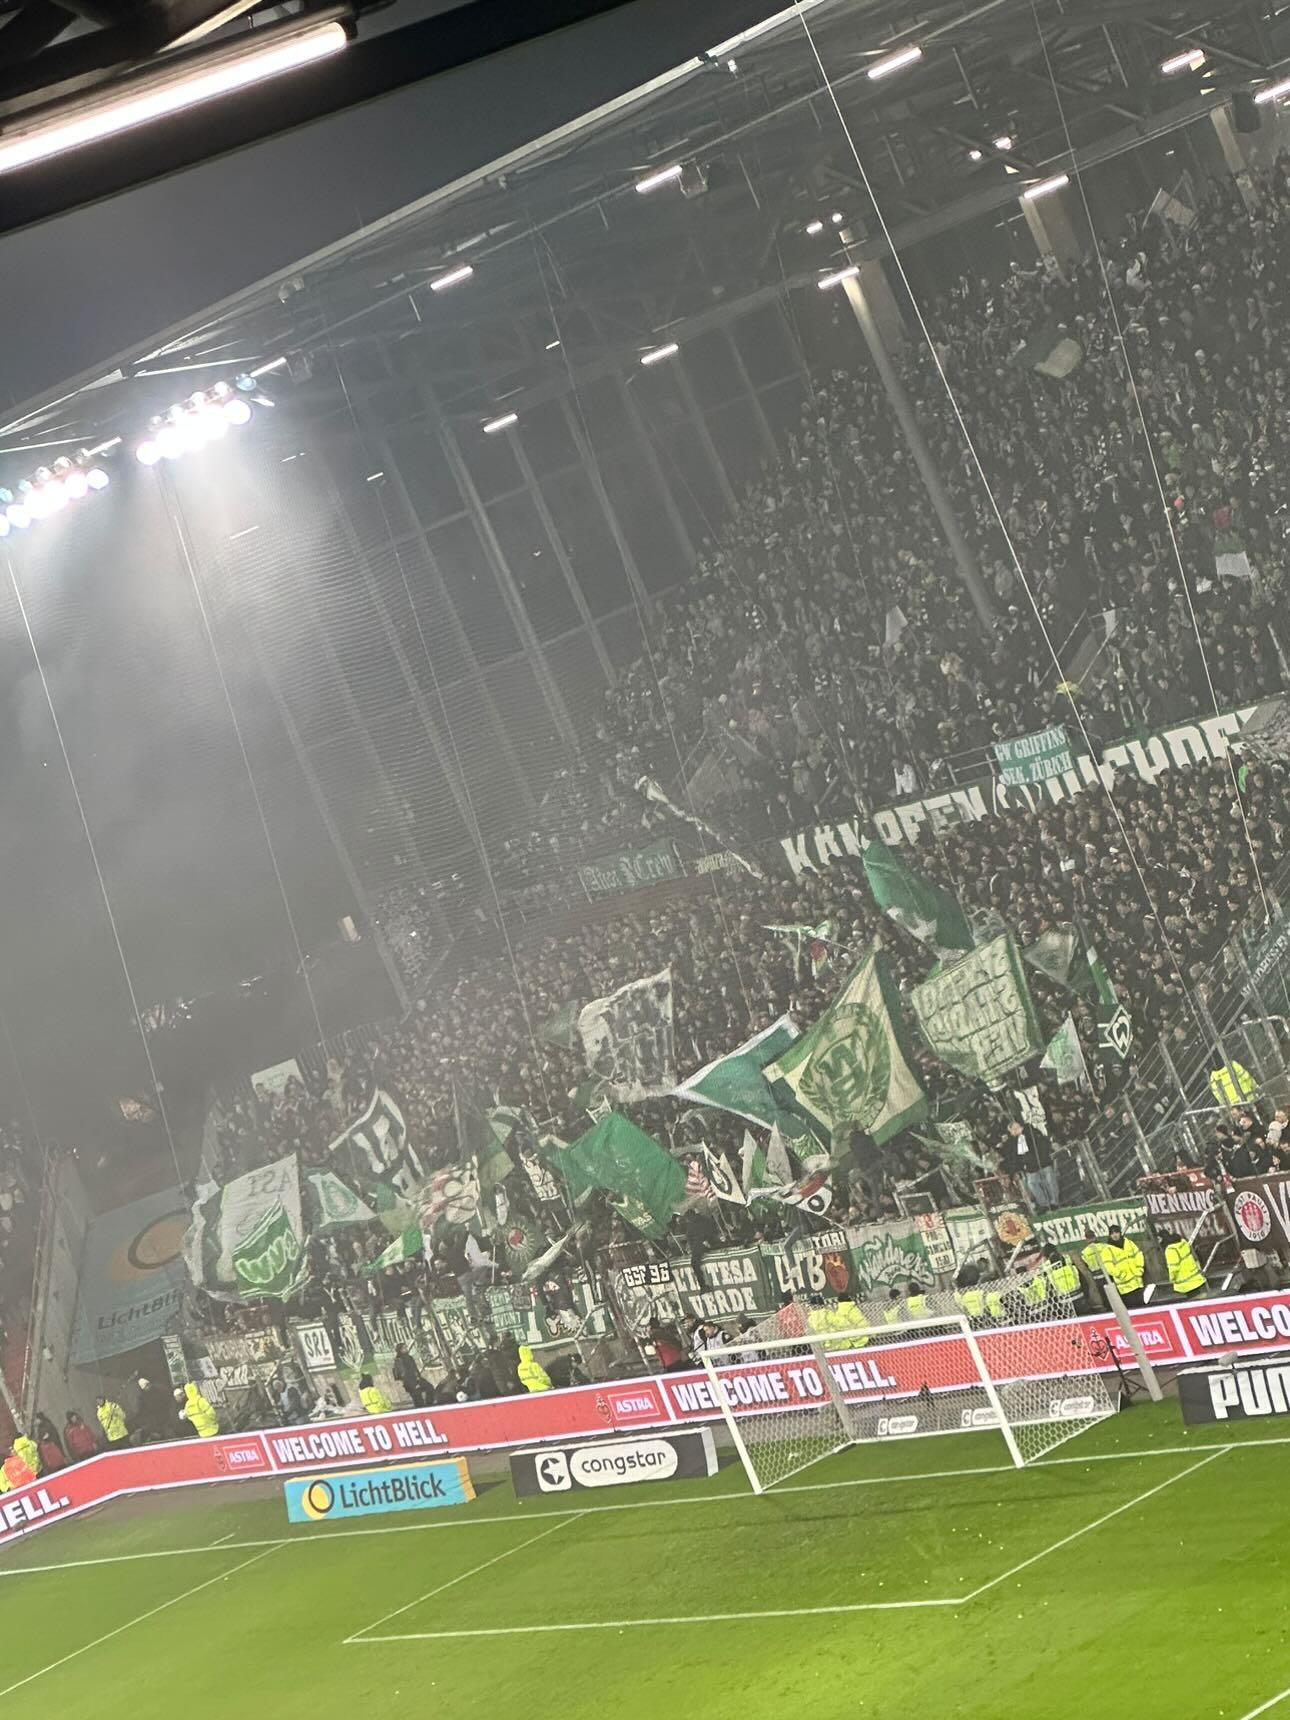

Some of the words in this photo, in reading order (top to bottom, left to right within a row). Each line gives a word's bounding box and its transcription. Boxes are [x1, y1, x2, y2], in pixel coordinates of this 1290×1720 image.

[1029, 751, 1074, 781] ZÜRICH
[692, 1287, 756, 1319] VERDE
[305, 1336, 332, 1360] SRL
[788, 1367, 824, 1397] TO
[615, 1395, 655, 1415] ASTRA
[272, 1430, 365, 1463] WELCOME
[366, 1425, 392, 1451] TO
[393, 1418, 448, 1447] HELL.
[229, 1449, 259, 1464] ASTRA
[581, 1449, 666, 1476] congstar
[340, 1473, 447, 1508] LichtBlick
